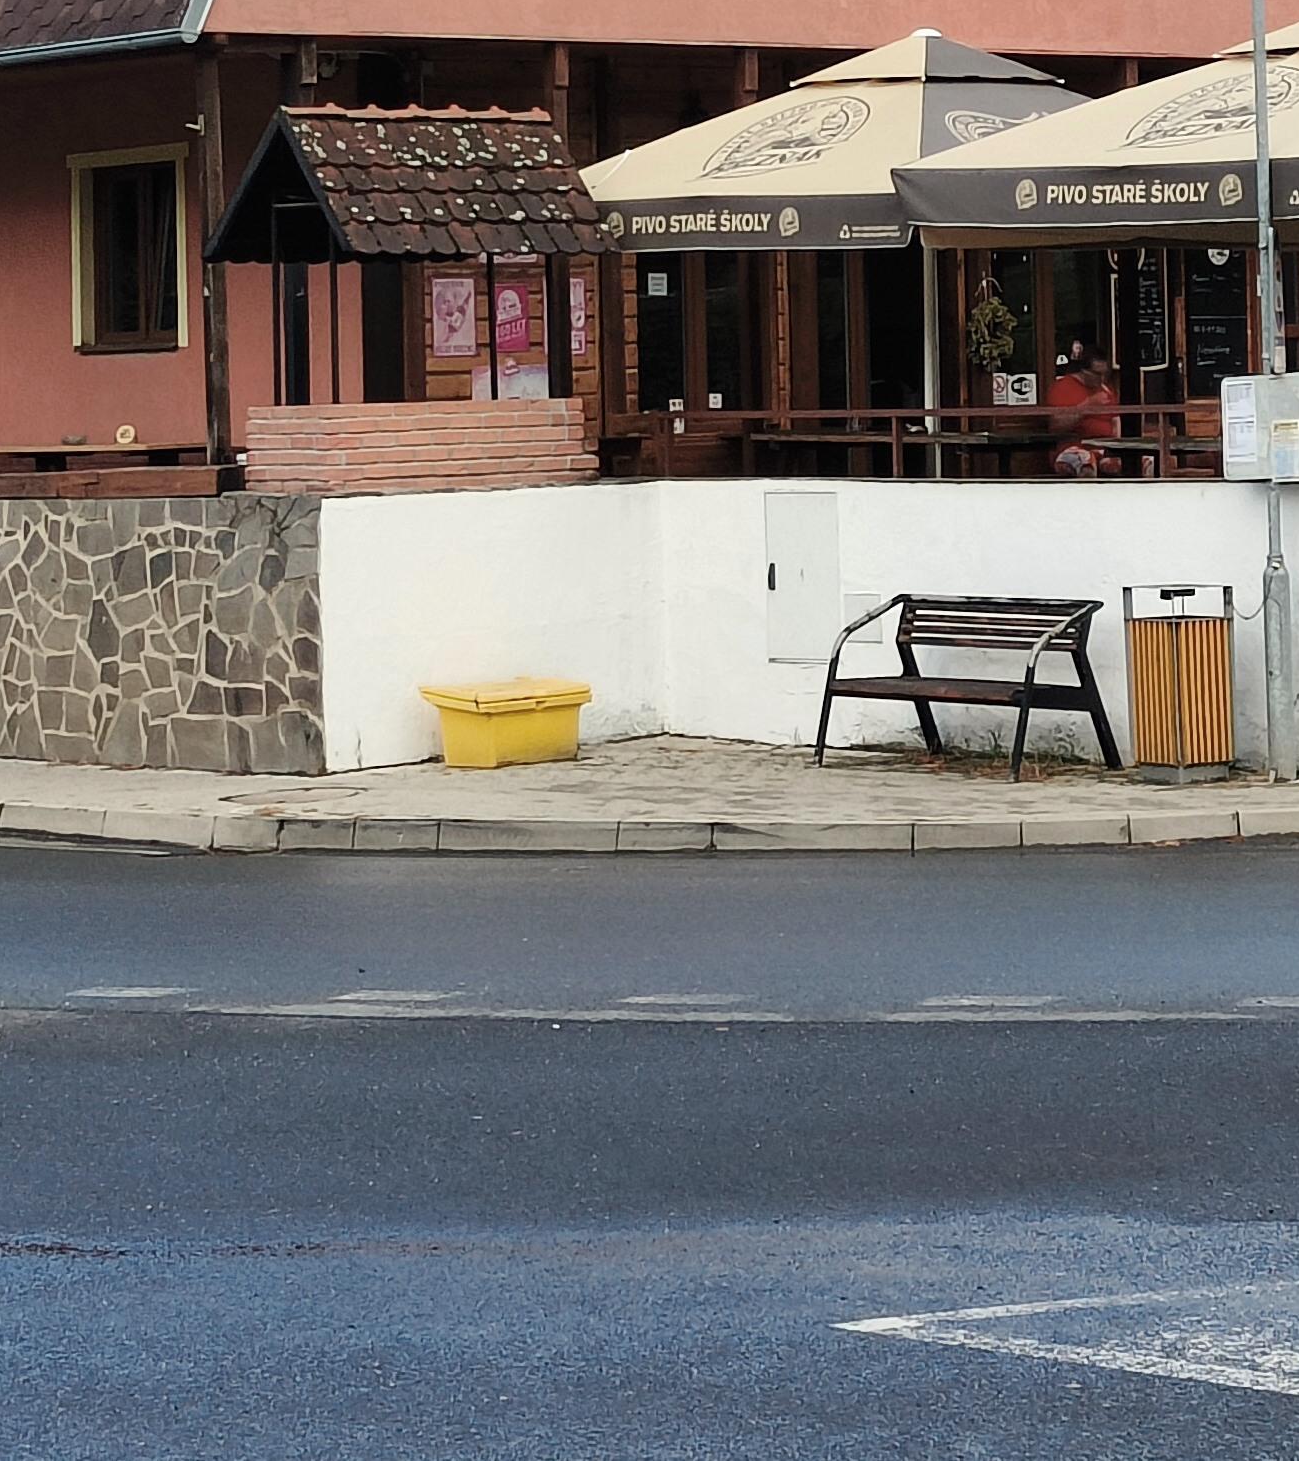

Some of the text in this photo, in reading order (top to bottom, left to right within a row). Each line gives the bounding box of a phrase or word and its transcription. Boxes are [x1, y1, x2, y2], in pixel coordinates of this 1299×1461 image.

[1046, 179, 1210, 205] PIVO STARÉ ŠKOLY
[632, 208, 772, 235] PIVO STARÉ ŠKOLY
